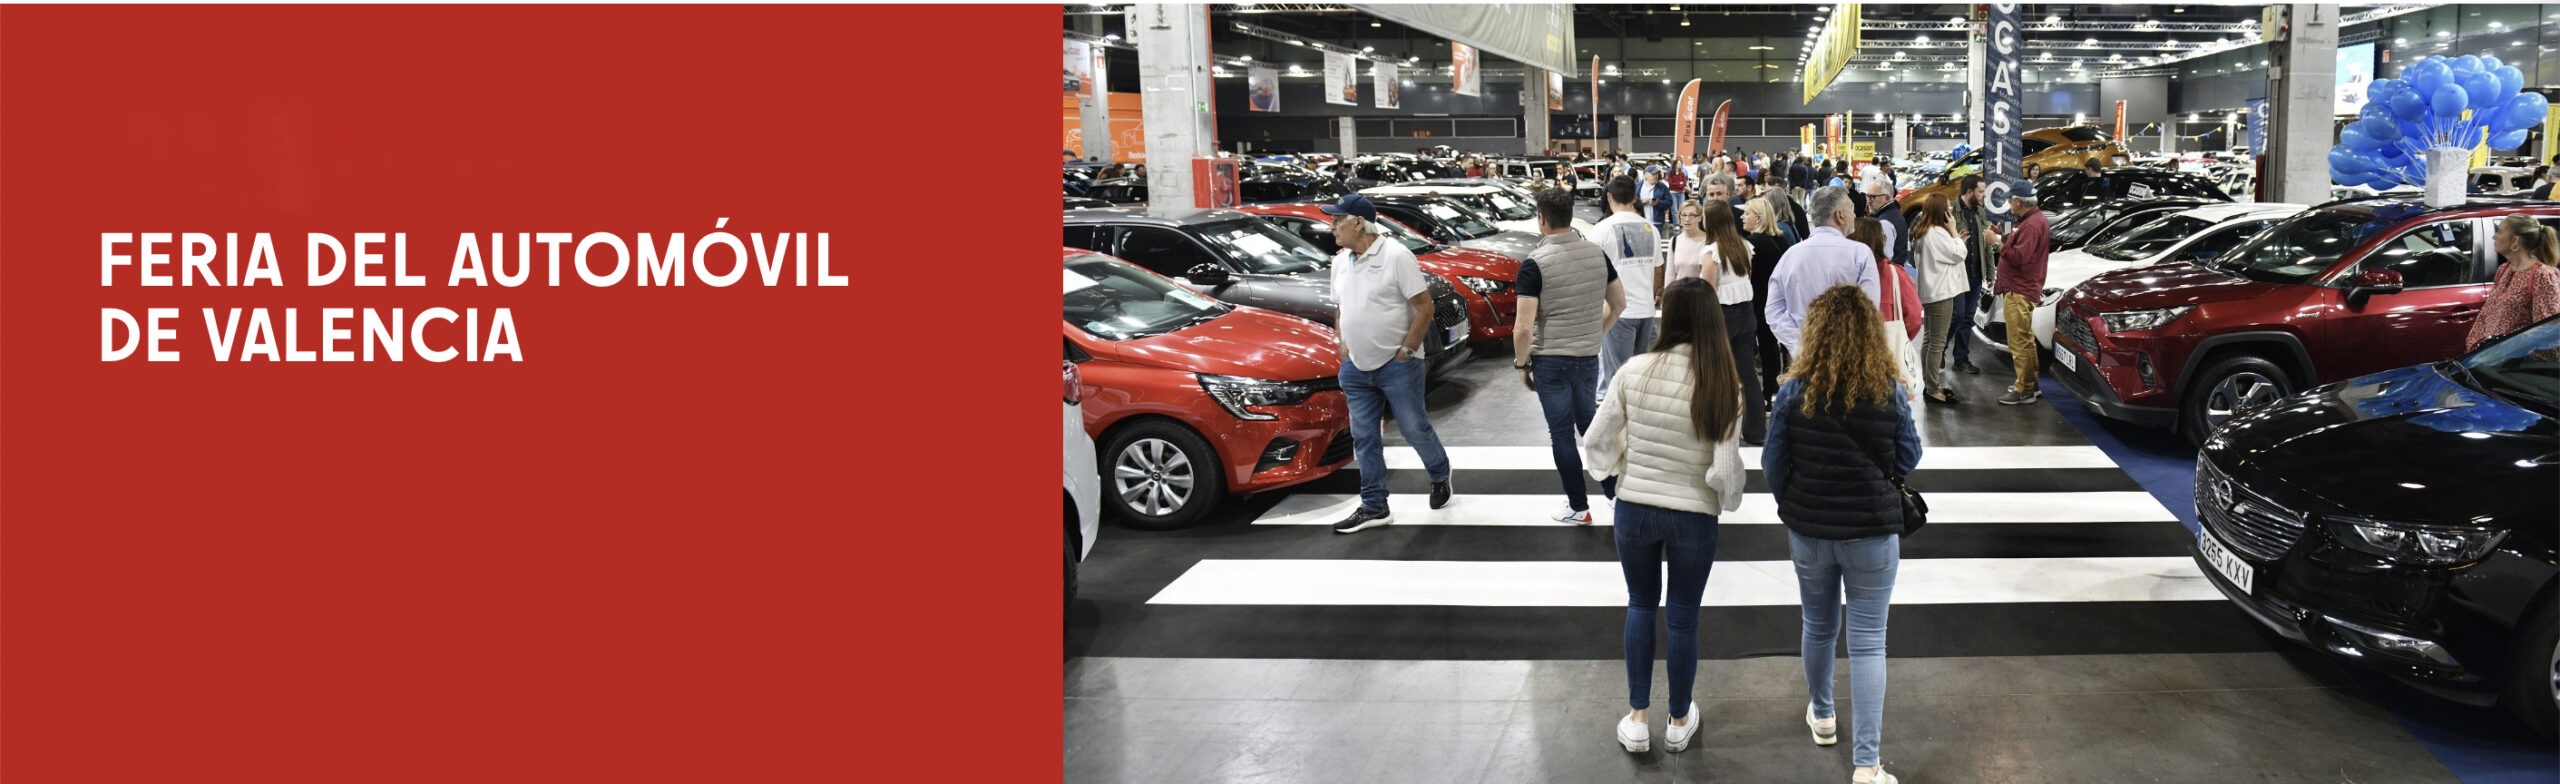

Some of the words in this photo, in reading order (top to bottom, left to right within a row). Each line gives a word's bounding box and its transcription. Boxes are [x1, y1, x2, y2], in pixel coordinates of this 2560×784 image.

[1683, 120, 1692, 143] Flexi
[2201, 532, 2223, 568] 3255
[2226, 555, 2250, 588] KXV
